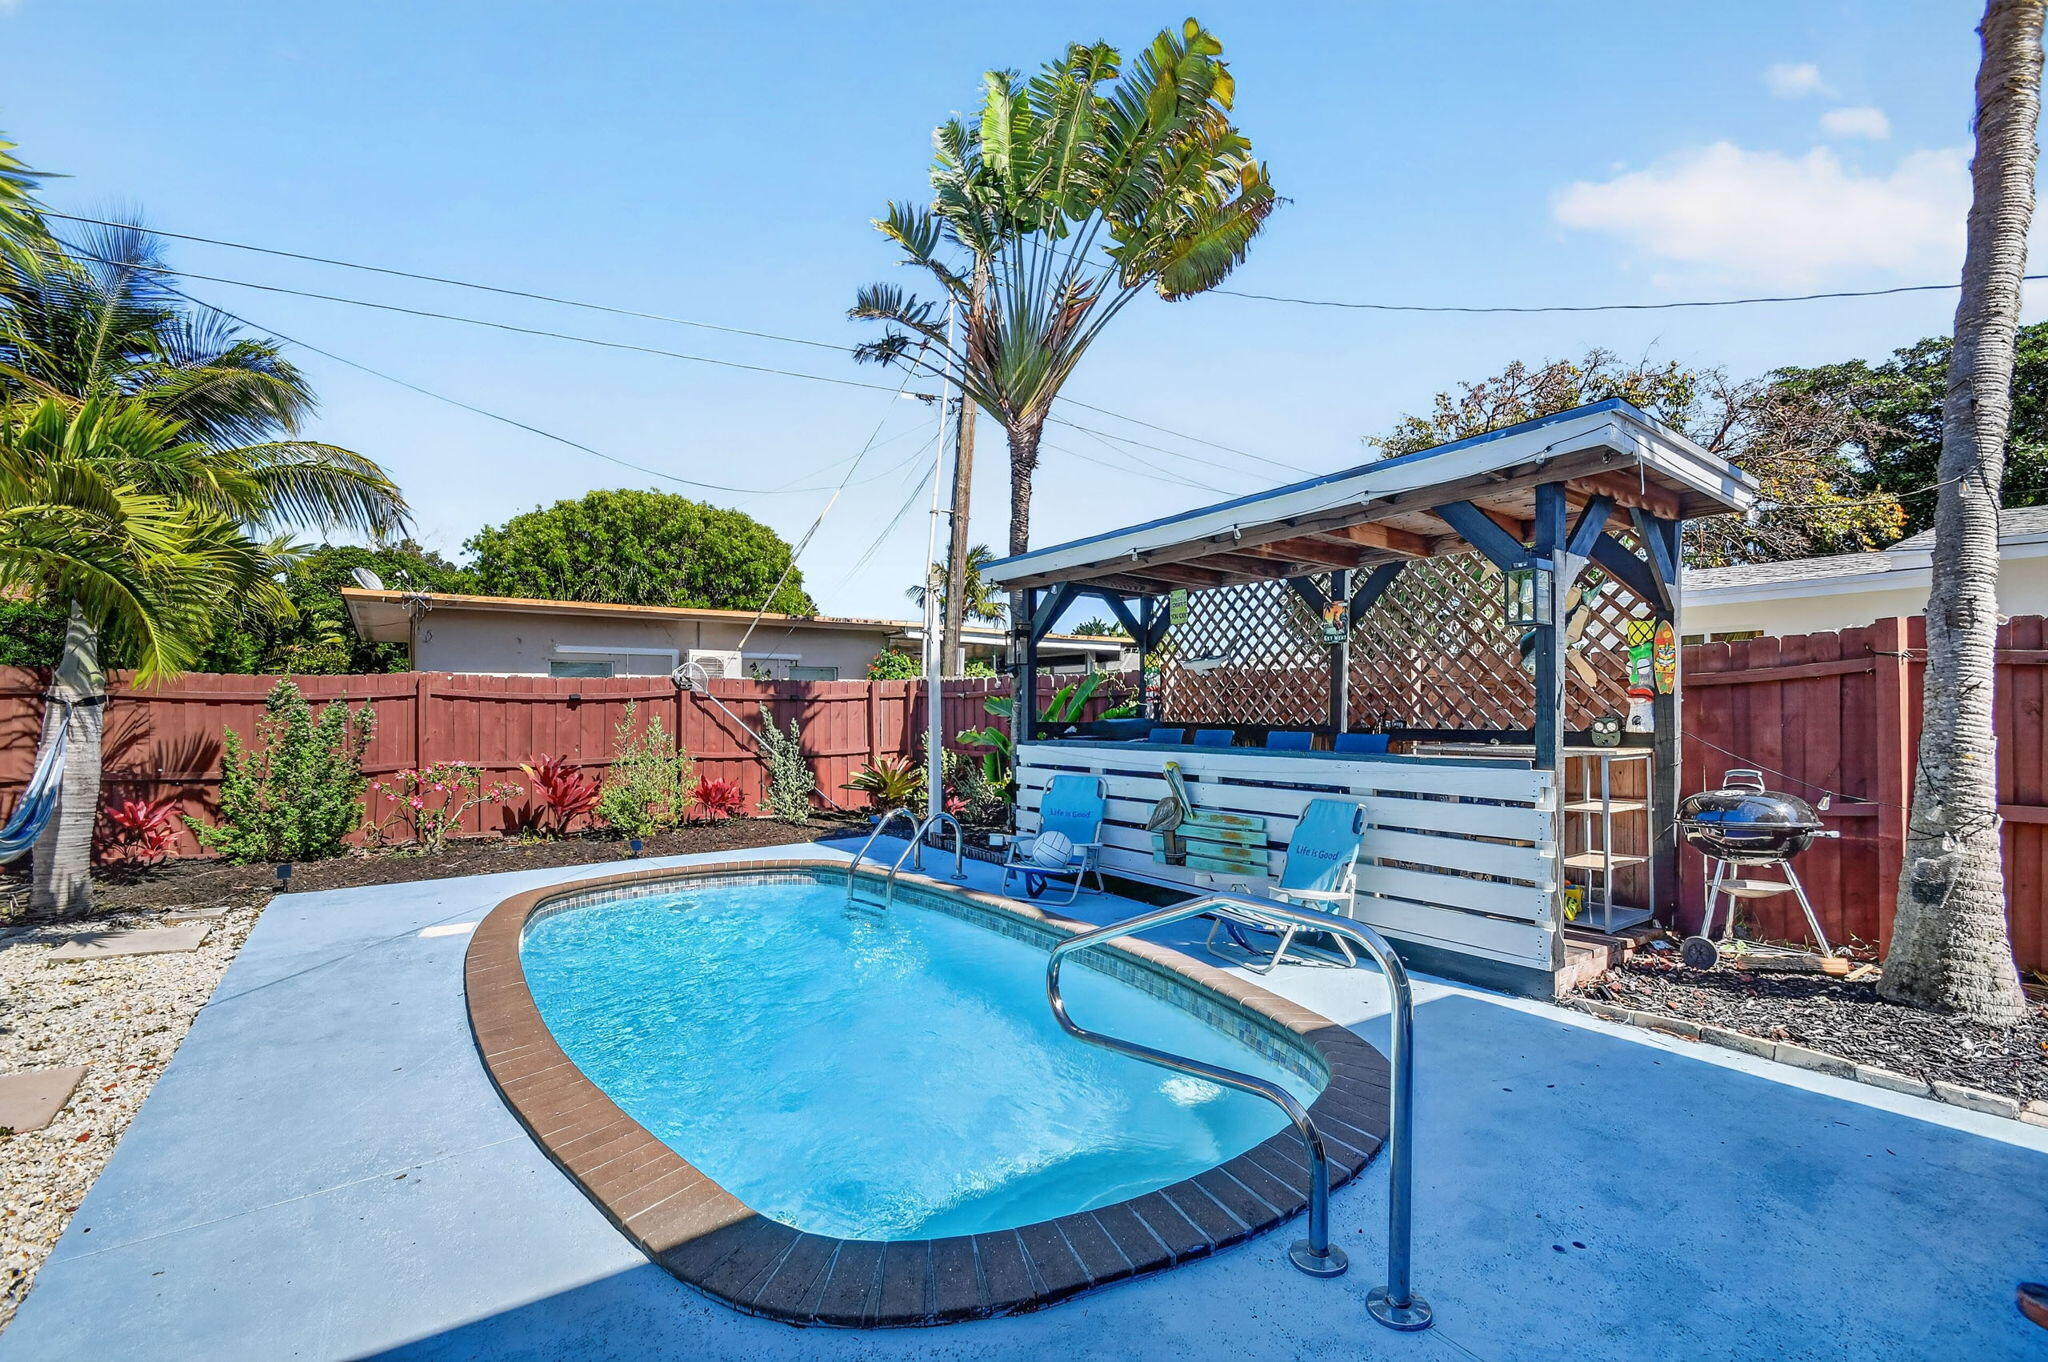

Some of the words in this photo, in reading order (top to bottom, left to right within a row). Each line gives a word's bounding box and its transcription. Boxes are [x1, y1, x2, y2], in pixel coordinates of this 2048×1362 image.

[1050, 808, 1065, 816] Life
[1072, 810, 1091, 818] Good
[1296, 845, 1310, 856] Life
[1311, 848, 1318, 857] is
[1318, 850, 1340, 861] Good
